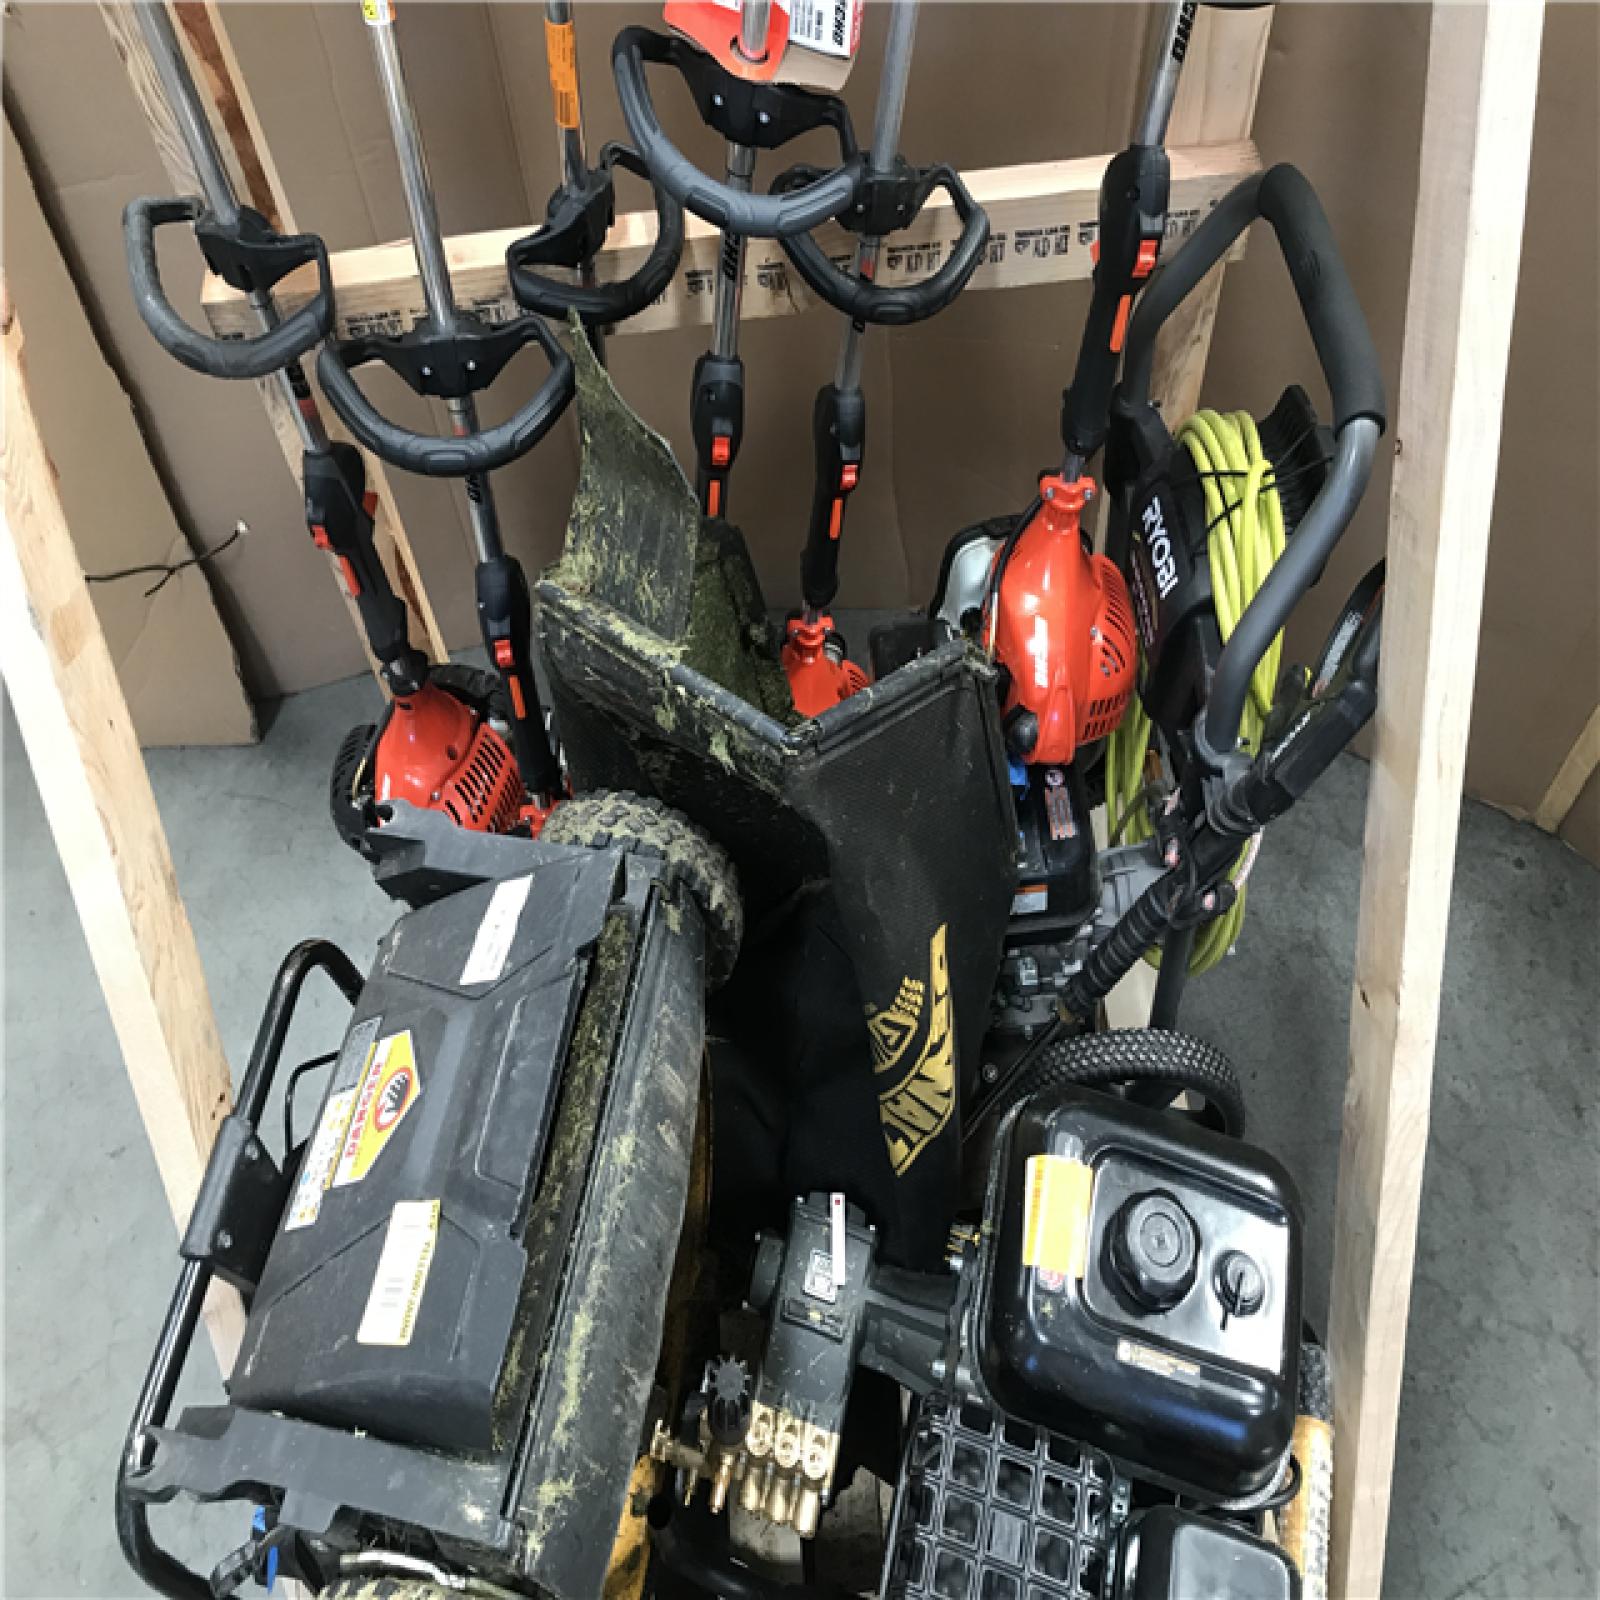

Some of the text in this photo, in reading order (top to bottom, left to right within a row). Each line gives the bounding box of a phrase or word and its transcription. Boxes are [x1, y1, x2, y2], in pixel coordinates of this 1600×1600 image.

[1171, 2, 1197, 63] CHO
[722, 230, 740, 281] CHO
[1142, 495, 1178, 600] RYOBI
